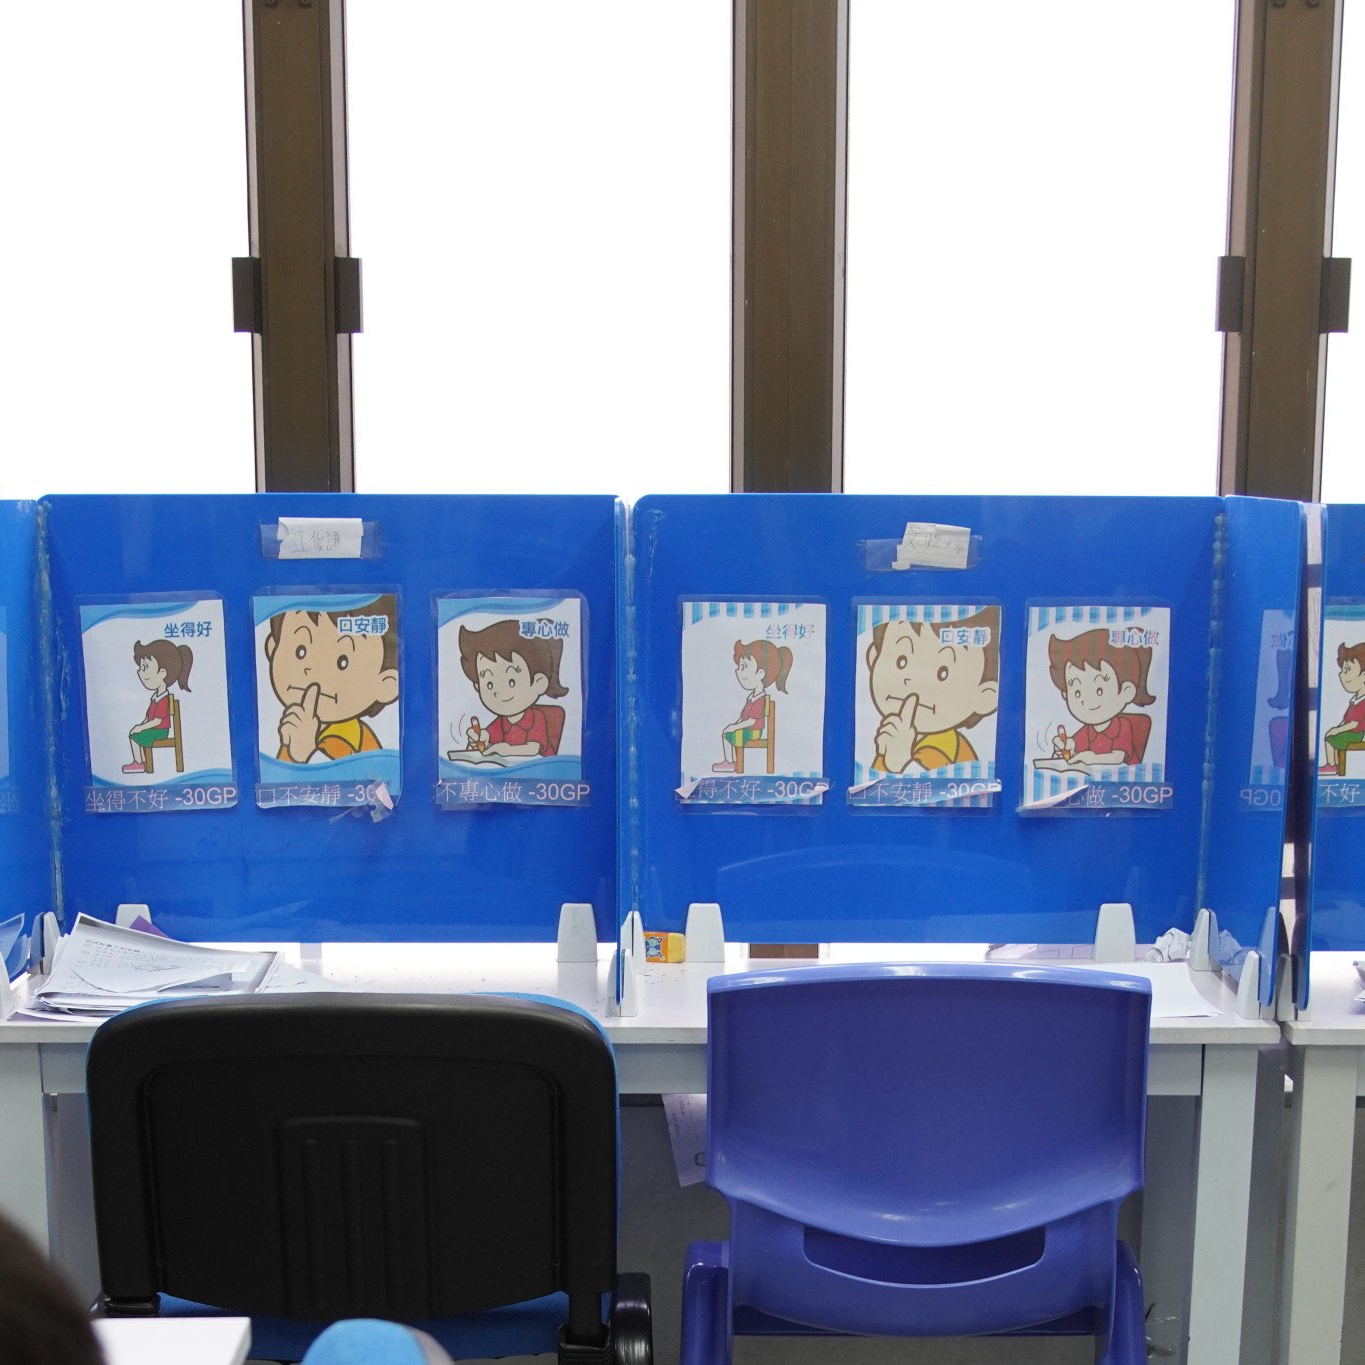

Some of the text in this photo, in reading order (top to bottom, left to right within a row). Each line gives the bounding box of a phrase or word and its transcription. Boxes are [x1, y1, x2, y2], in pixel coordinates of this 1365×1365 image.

[164, 620, 213, 639] 坐得好
[338, 616, 388, 636] 口安靜
[519, 619, 570, 639] 專心做
[765, 623, 815, 641] 坐得好
[940, 628, 990, 648] 口安靜
[1109, 629, 1159, 648] 專心做
[85, 787, 237, 812] 坐得不好 -30GP
[257, 785, 341, 806] 口不安靜
[438, 781, 591, 802] 不專心做 -30GP
[691, 779, 762, 800] 得不好
[1111, 786, 1173, 804] -30GP
